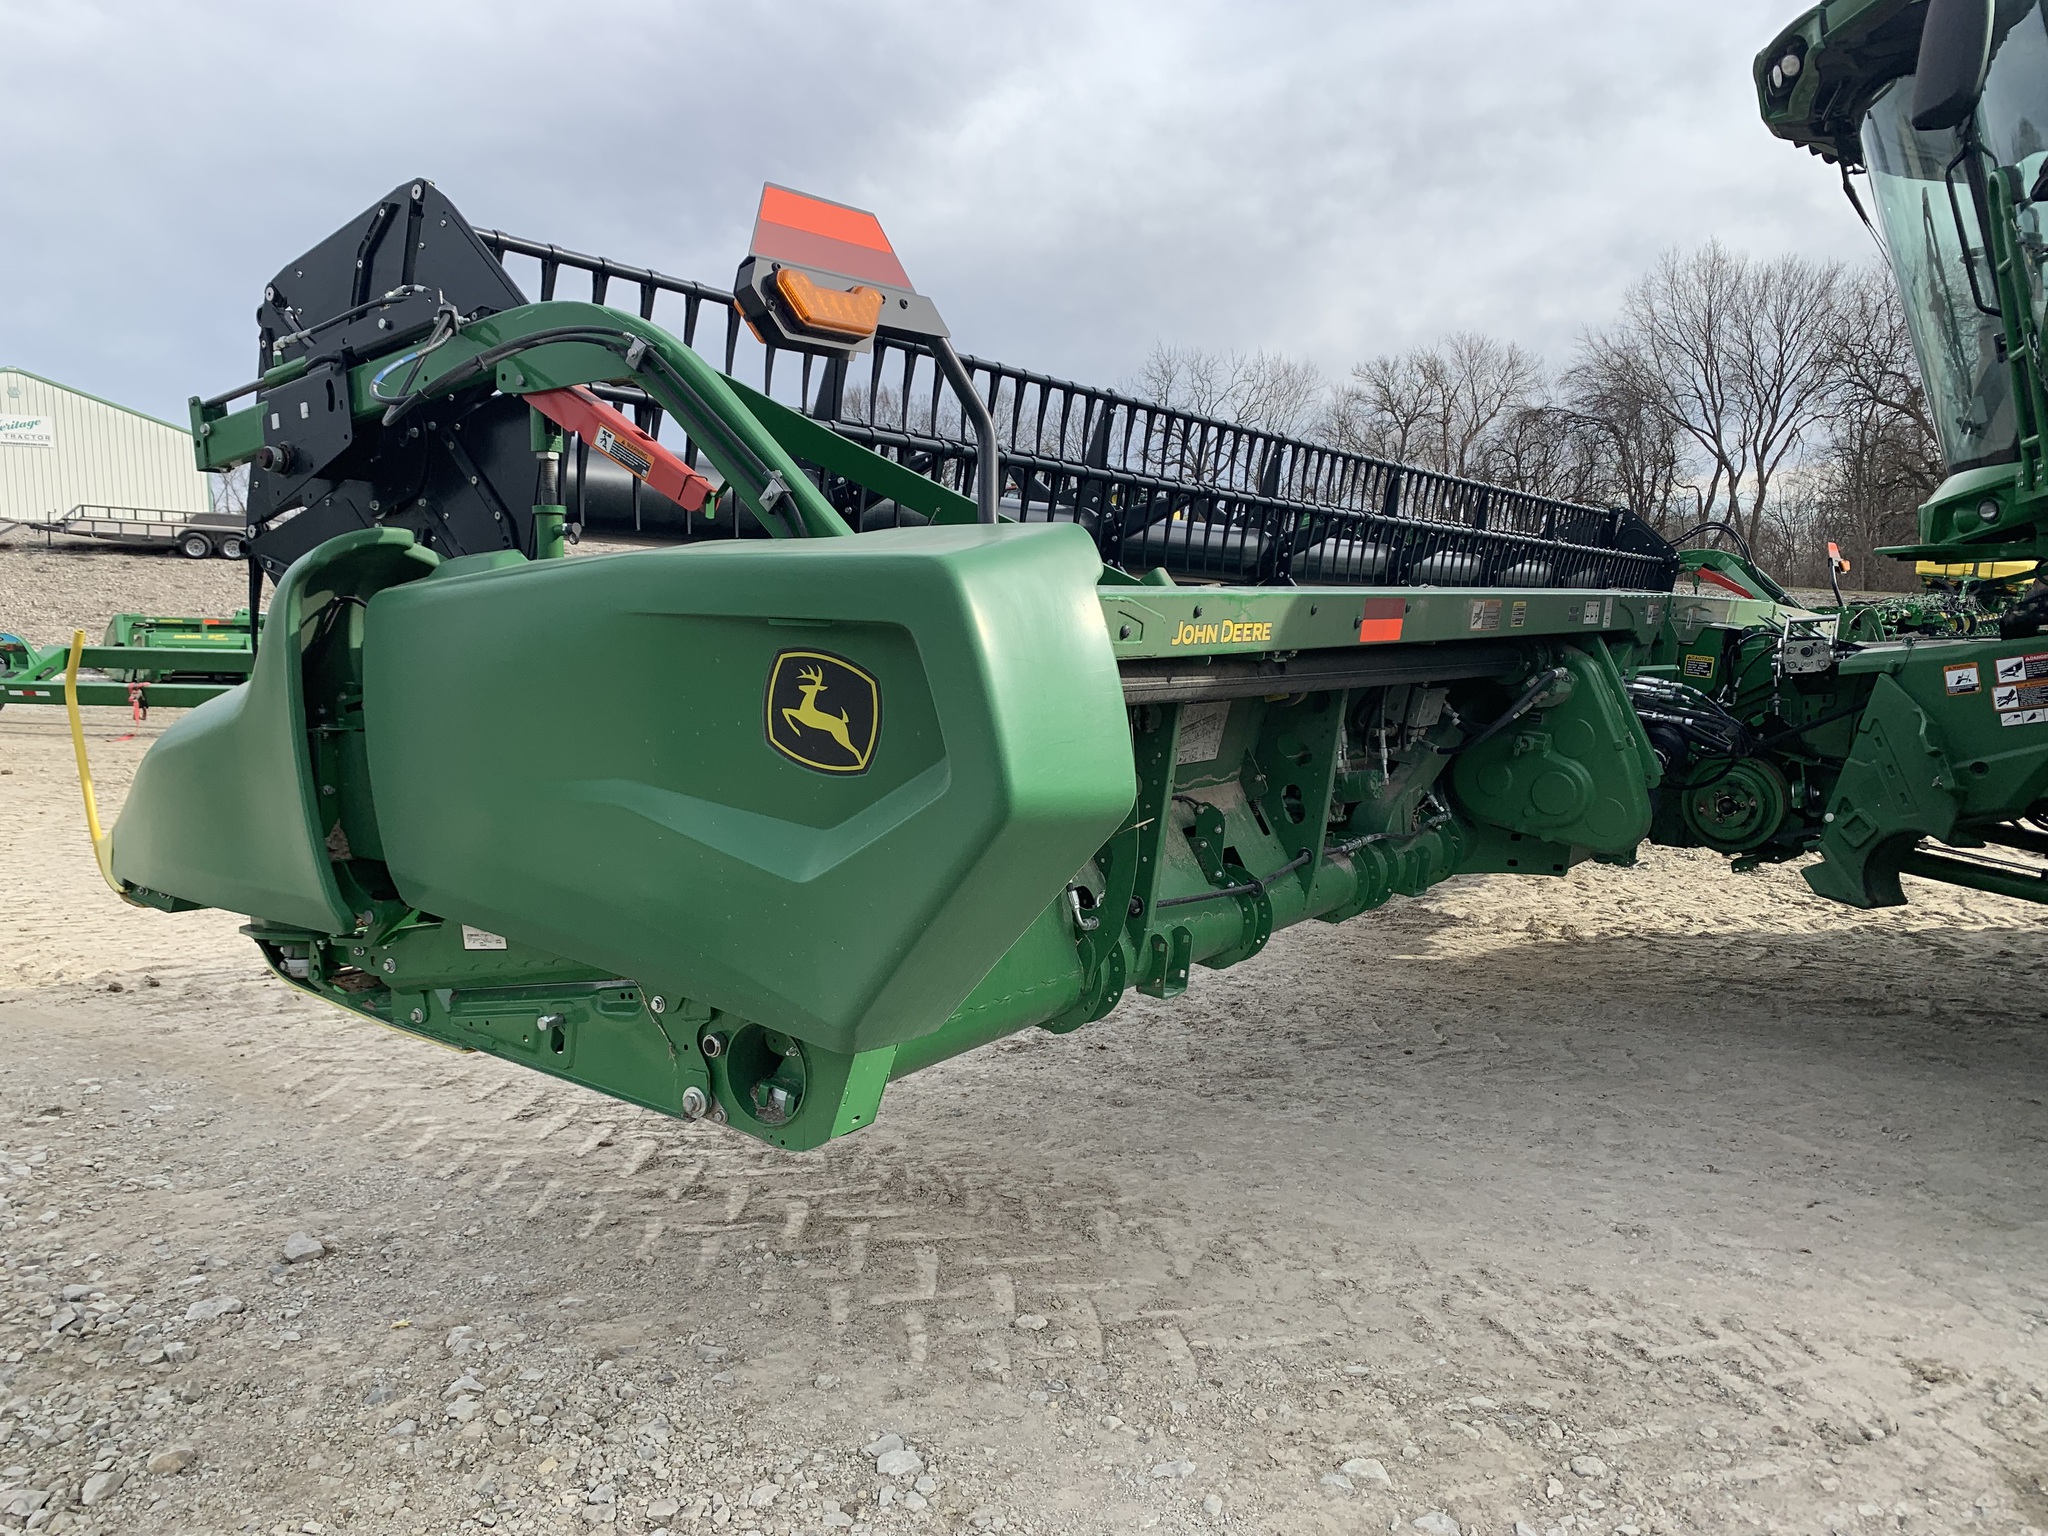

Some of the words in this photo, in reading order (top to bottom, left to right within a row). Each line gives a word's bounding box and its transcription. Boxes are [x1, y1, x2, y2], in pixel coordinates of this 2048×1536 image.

[0, 419, 41, 431] eritage
[626, 441, 648, 459] WARNING
[1171, 620, 1219, 646] JOHN
[1220, 619, 1273, 643] DEERE
